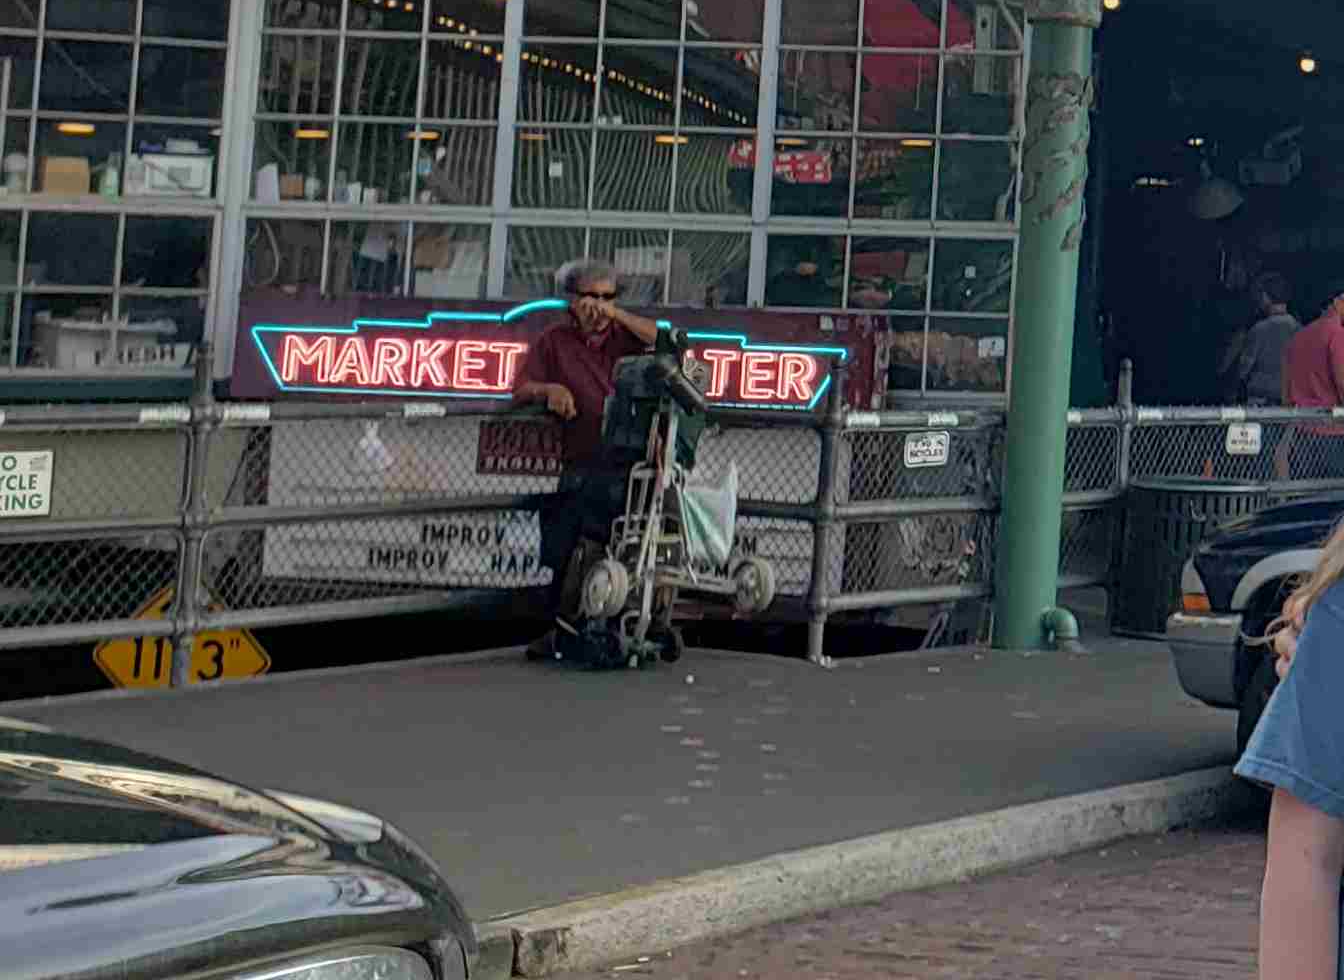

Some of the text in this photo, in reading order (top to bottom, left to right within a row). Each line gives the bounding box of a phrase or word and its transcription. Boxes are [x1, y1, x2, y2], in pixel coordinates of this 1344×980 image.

[281, 334, 817, 400] MARKET TER
[421, 523, 507, 546] IMPROV
[367, 548, 450, 570] IMPROV
